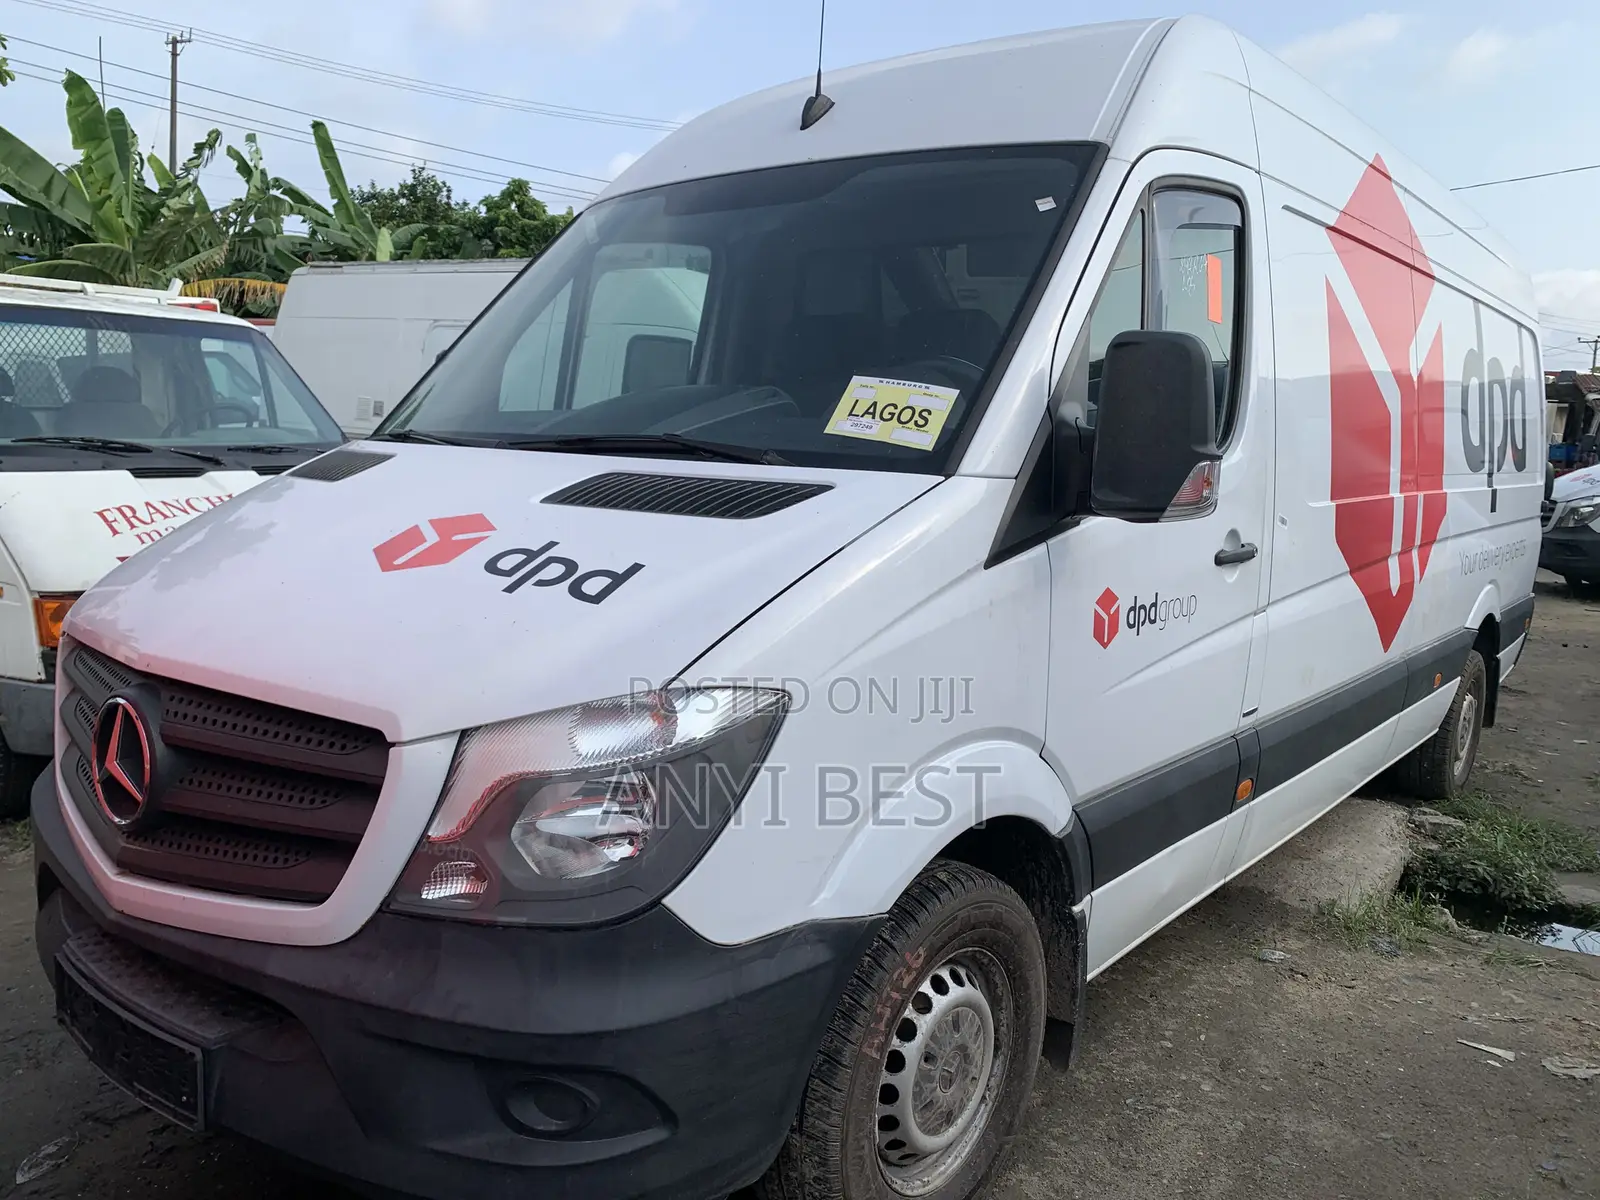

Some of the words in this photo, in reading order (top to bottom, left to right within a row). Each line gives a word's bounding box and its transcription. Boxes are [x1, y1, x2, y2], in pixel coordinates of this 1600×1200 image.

[885, 380, 923, 389] HAMBURG
[847, 399, 932, 428] LAGOS
[1460, 300, 1527, 513] dpd
[483, 540, 646, 605] dpd
[1459, 551, 1478, 576] Your
